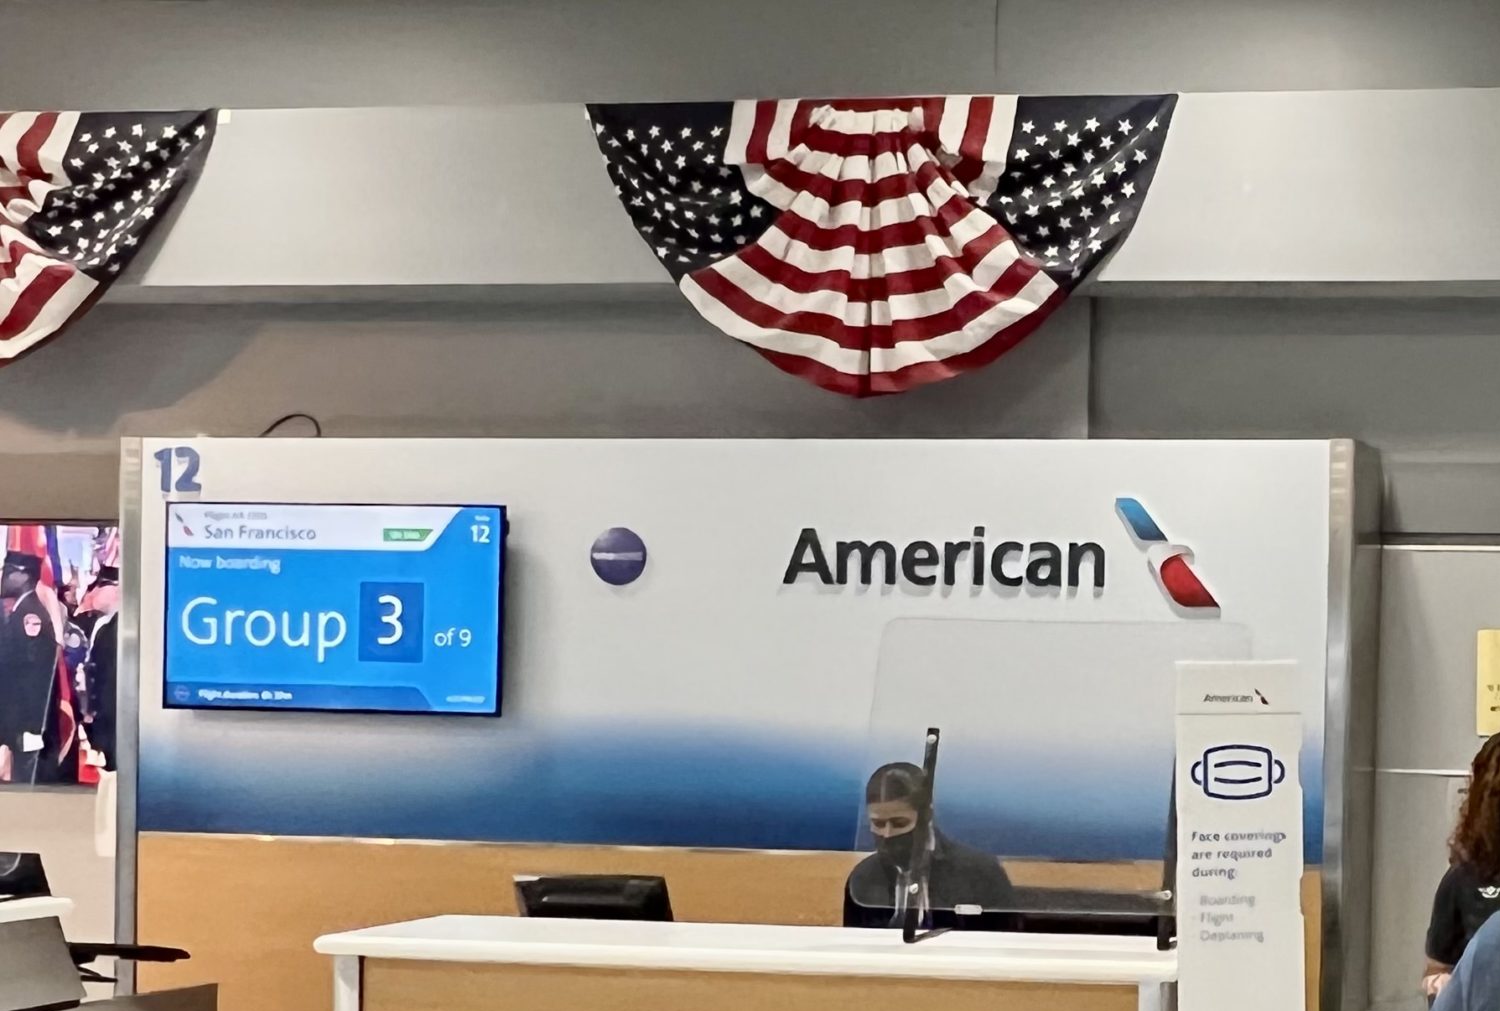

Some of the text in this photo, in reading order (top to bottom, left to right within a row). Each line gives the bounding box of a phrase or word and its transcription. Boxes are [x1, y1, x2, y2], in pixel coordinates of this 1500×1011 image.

[154, 446, 203, 493] 12
[203, 524, 317, 541] San Francisco
[470, 524, 491, 544] 12
[179, 555, 281, 575] Now boarding
[783, 525, 1107, 588] American
[181, 593, 472, 663] Group 3 of 9
[1191, 831, 1220, 842] Face
[1191, 848, 1273, 862] are required
[1191, 867, 1236, 880] during
